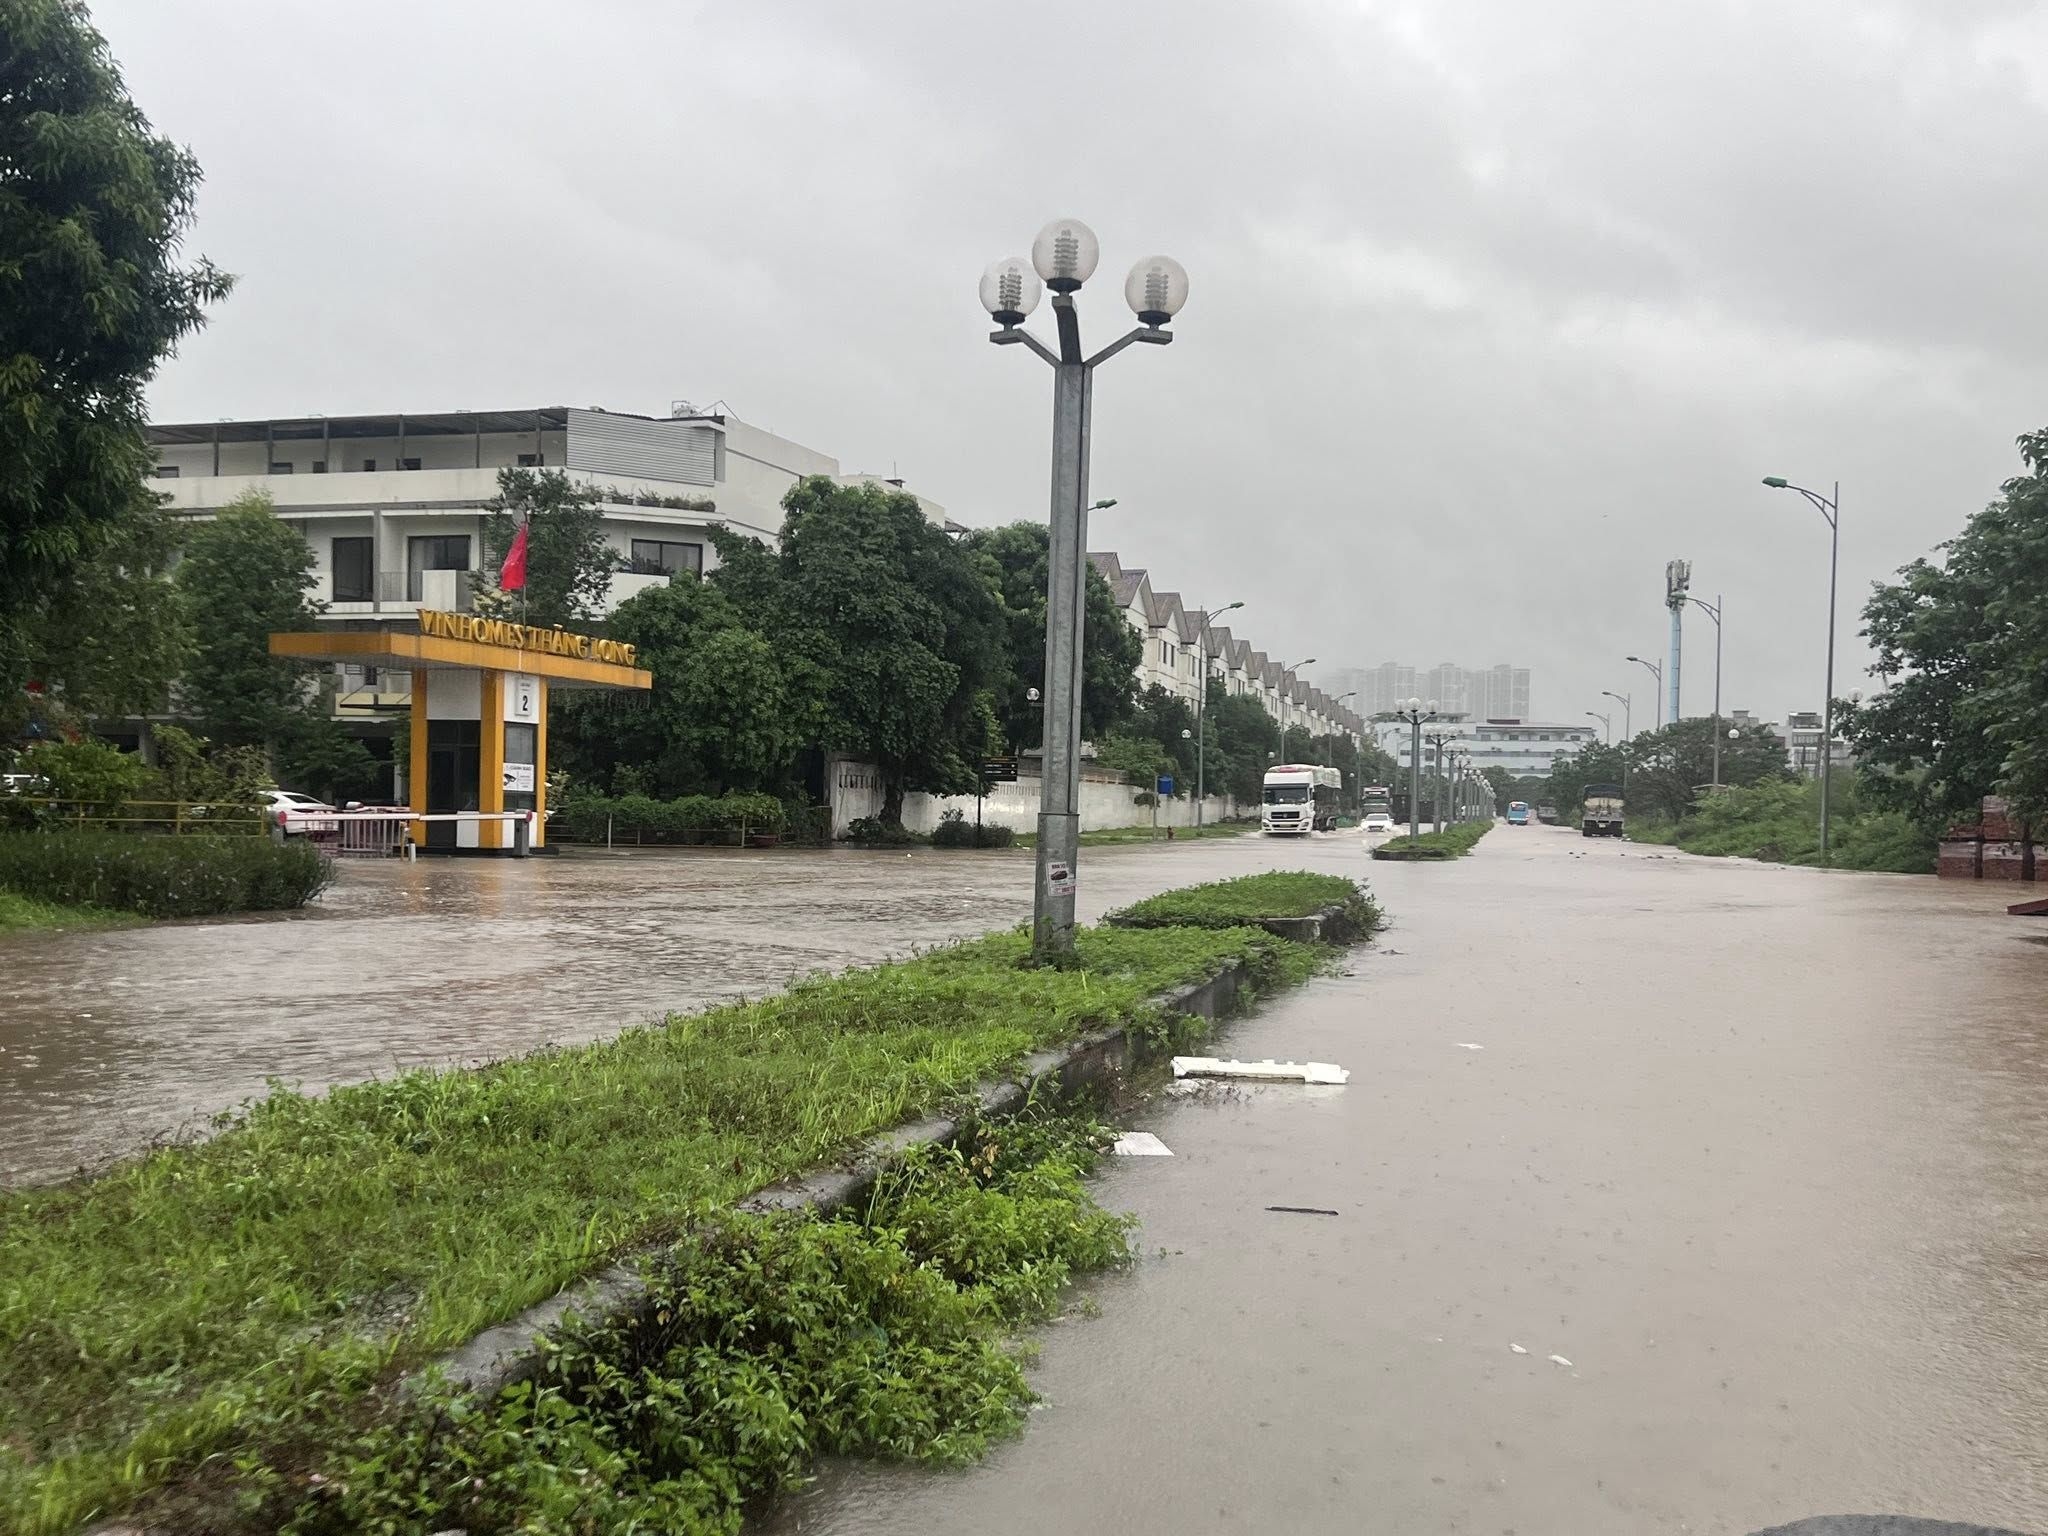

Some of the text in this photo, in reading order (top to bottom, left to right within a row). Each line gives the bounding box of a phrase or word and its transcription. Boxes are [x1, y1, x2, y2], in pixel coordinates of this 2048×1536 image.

[417, 608, 524, 648] VINHOMES
[590, 637, 636, 667] LONG
[522, 695, 528, 711] 2
